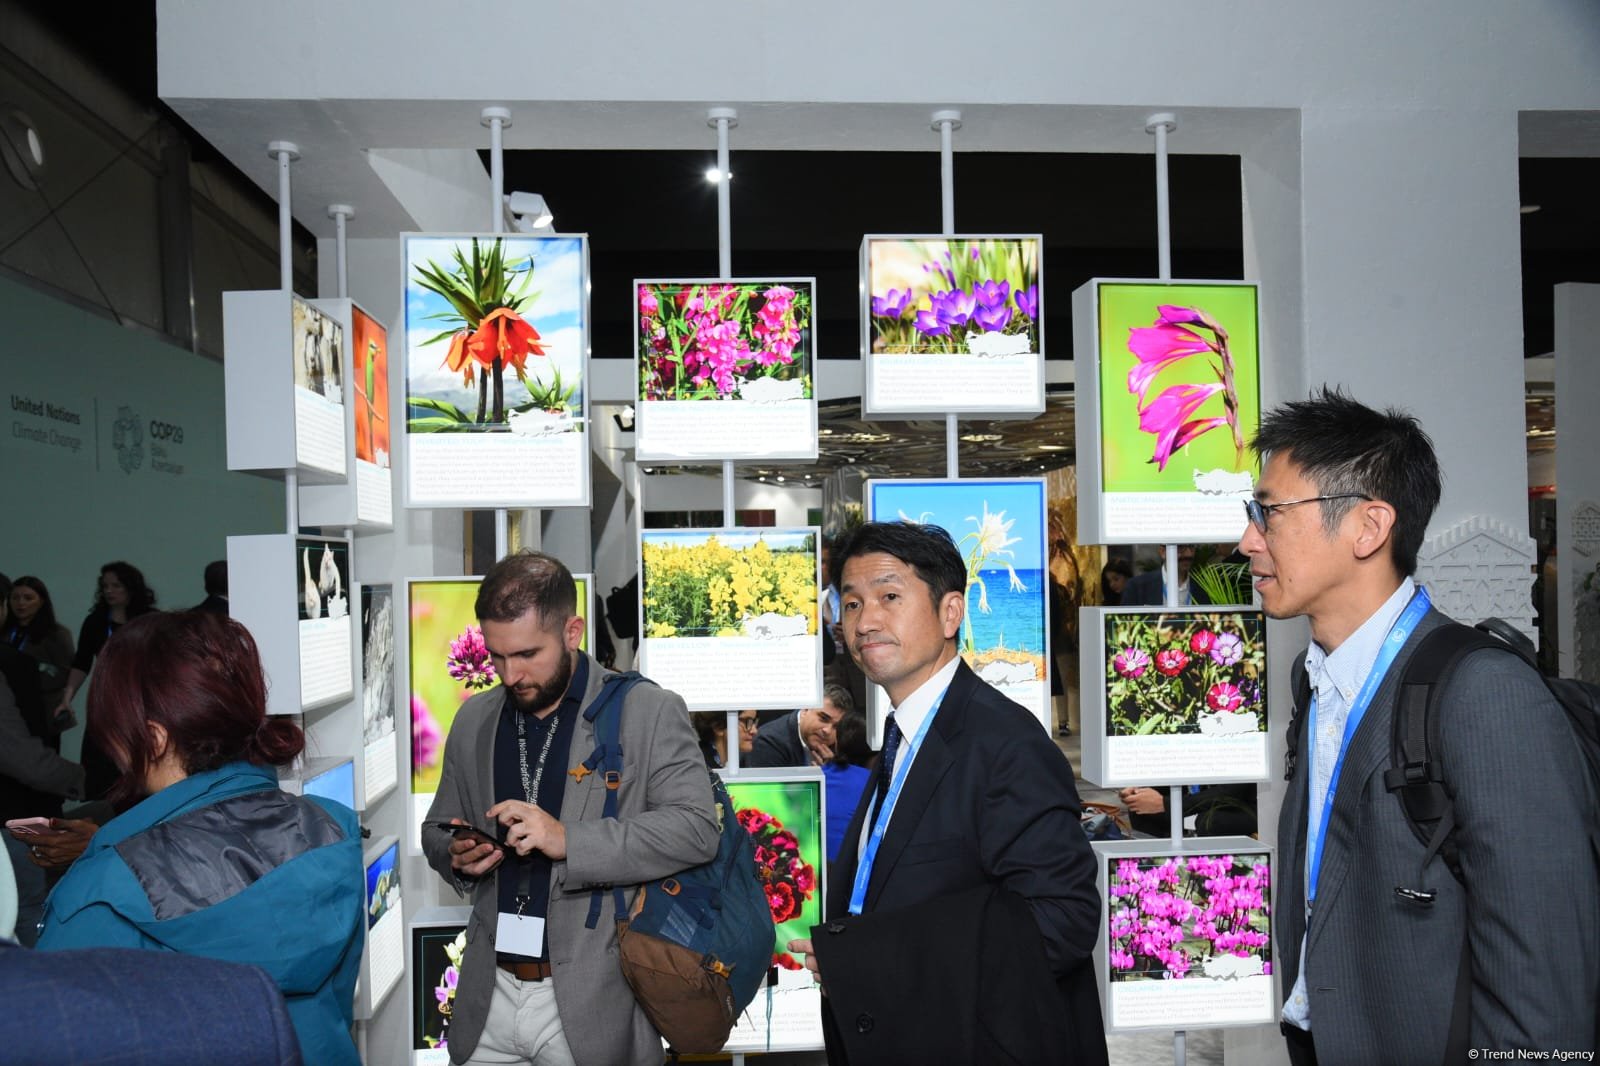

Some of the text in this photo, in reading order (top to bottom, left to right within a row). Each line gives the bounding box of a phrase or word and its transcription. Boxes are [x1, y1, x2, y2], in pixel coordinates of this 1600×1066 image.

[11, 394, 81, 425] United Nations
[12, 421, 48, 444] Climate
[150, 420, 184, 444] COP29
